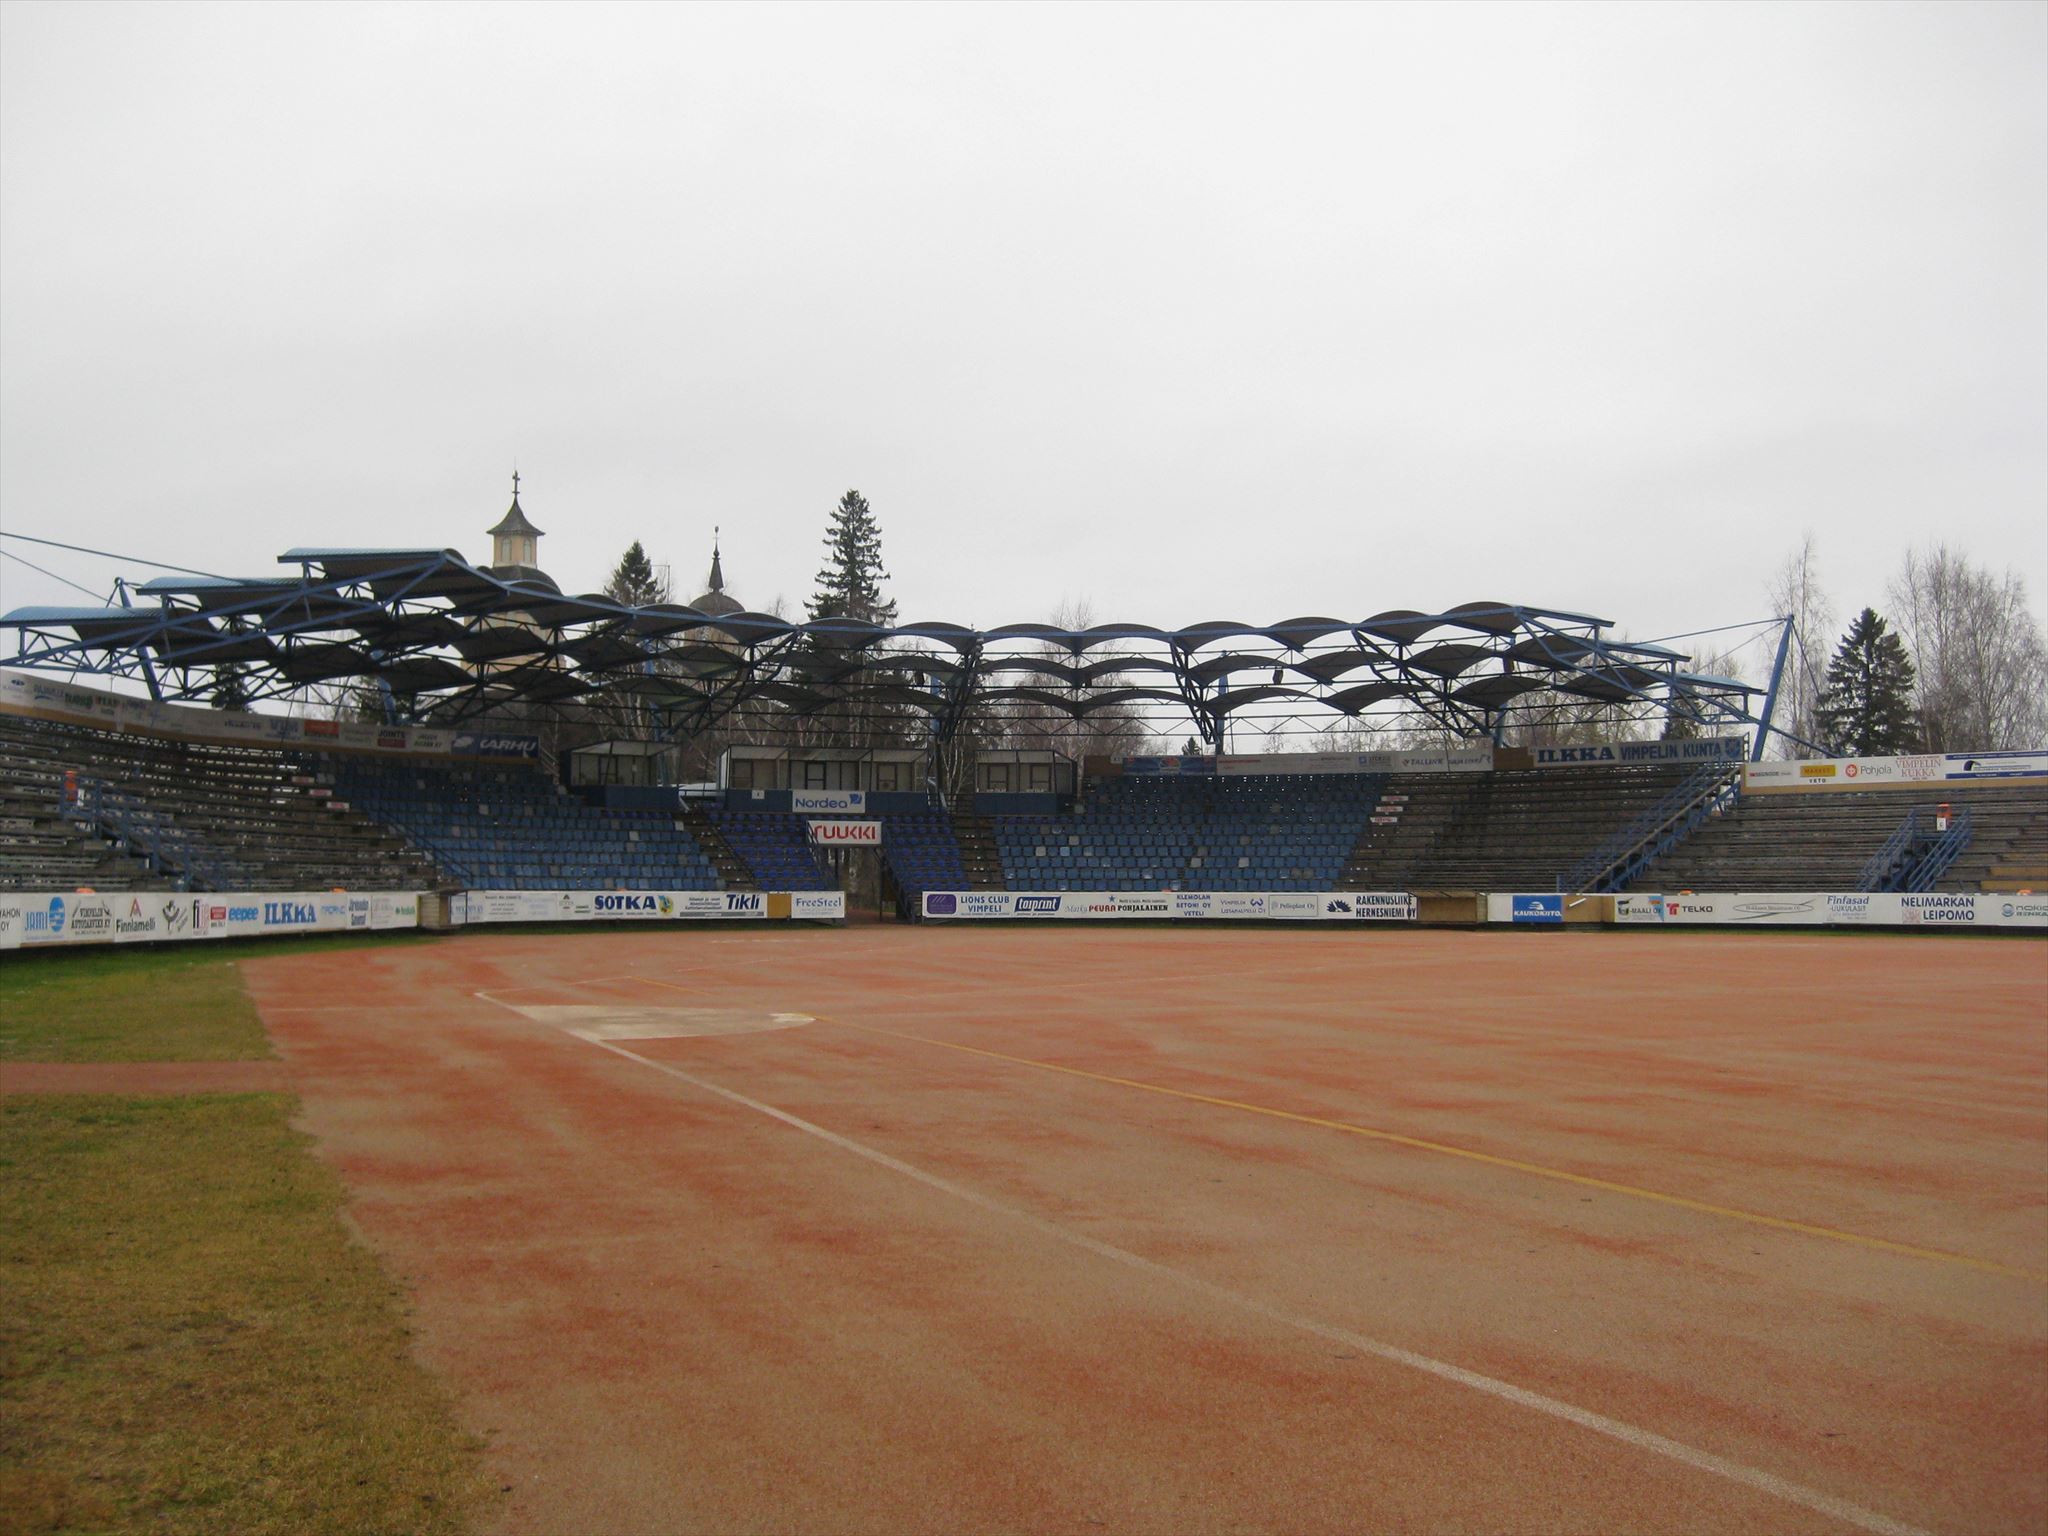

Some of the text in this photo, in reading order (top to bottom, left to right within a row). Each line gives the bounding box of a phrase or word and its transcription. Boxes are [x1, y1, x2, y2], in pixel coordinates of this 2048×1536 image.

[1538, 747, 1616, 763] ILKKA
[1621, 743, 1722, 760] VIMPELIN KUNTA
[1895, 758, 1941, 769] VIMPELIN
[1860, 764, 1892, 776] Pohjola
[1901, 768, 1936, 778] KUKKA
[795, 797, 848, 809] Nordea
[594, 895, 657, 910] SOTKA
[726, 893, 760, 910] Tikli
[796, 896, 842, 907] FreeSteel
[960, 895, 1010, 904] LIONS CLUB
[1356, 895, 1412, 906] RAKENNUSLIIKE
[1827, 895, 1869, 905] Finfasad
[1901, 897, 1975, 907] NELIMARKAN
[264, 902, 317, 925] ILKKA
[968, 904, 1002, 913] VIMPELI
[1117, 904, 1168, 912] POHJALAINEN
[1356, 907, 1405, 918] HERNESNIEMI
[229, 906, 259, 922] eepee
[1923, 910, 1975, 920] LEIPOMO
[116, 917, 156, 933] Finnlamelli
